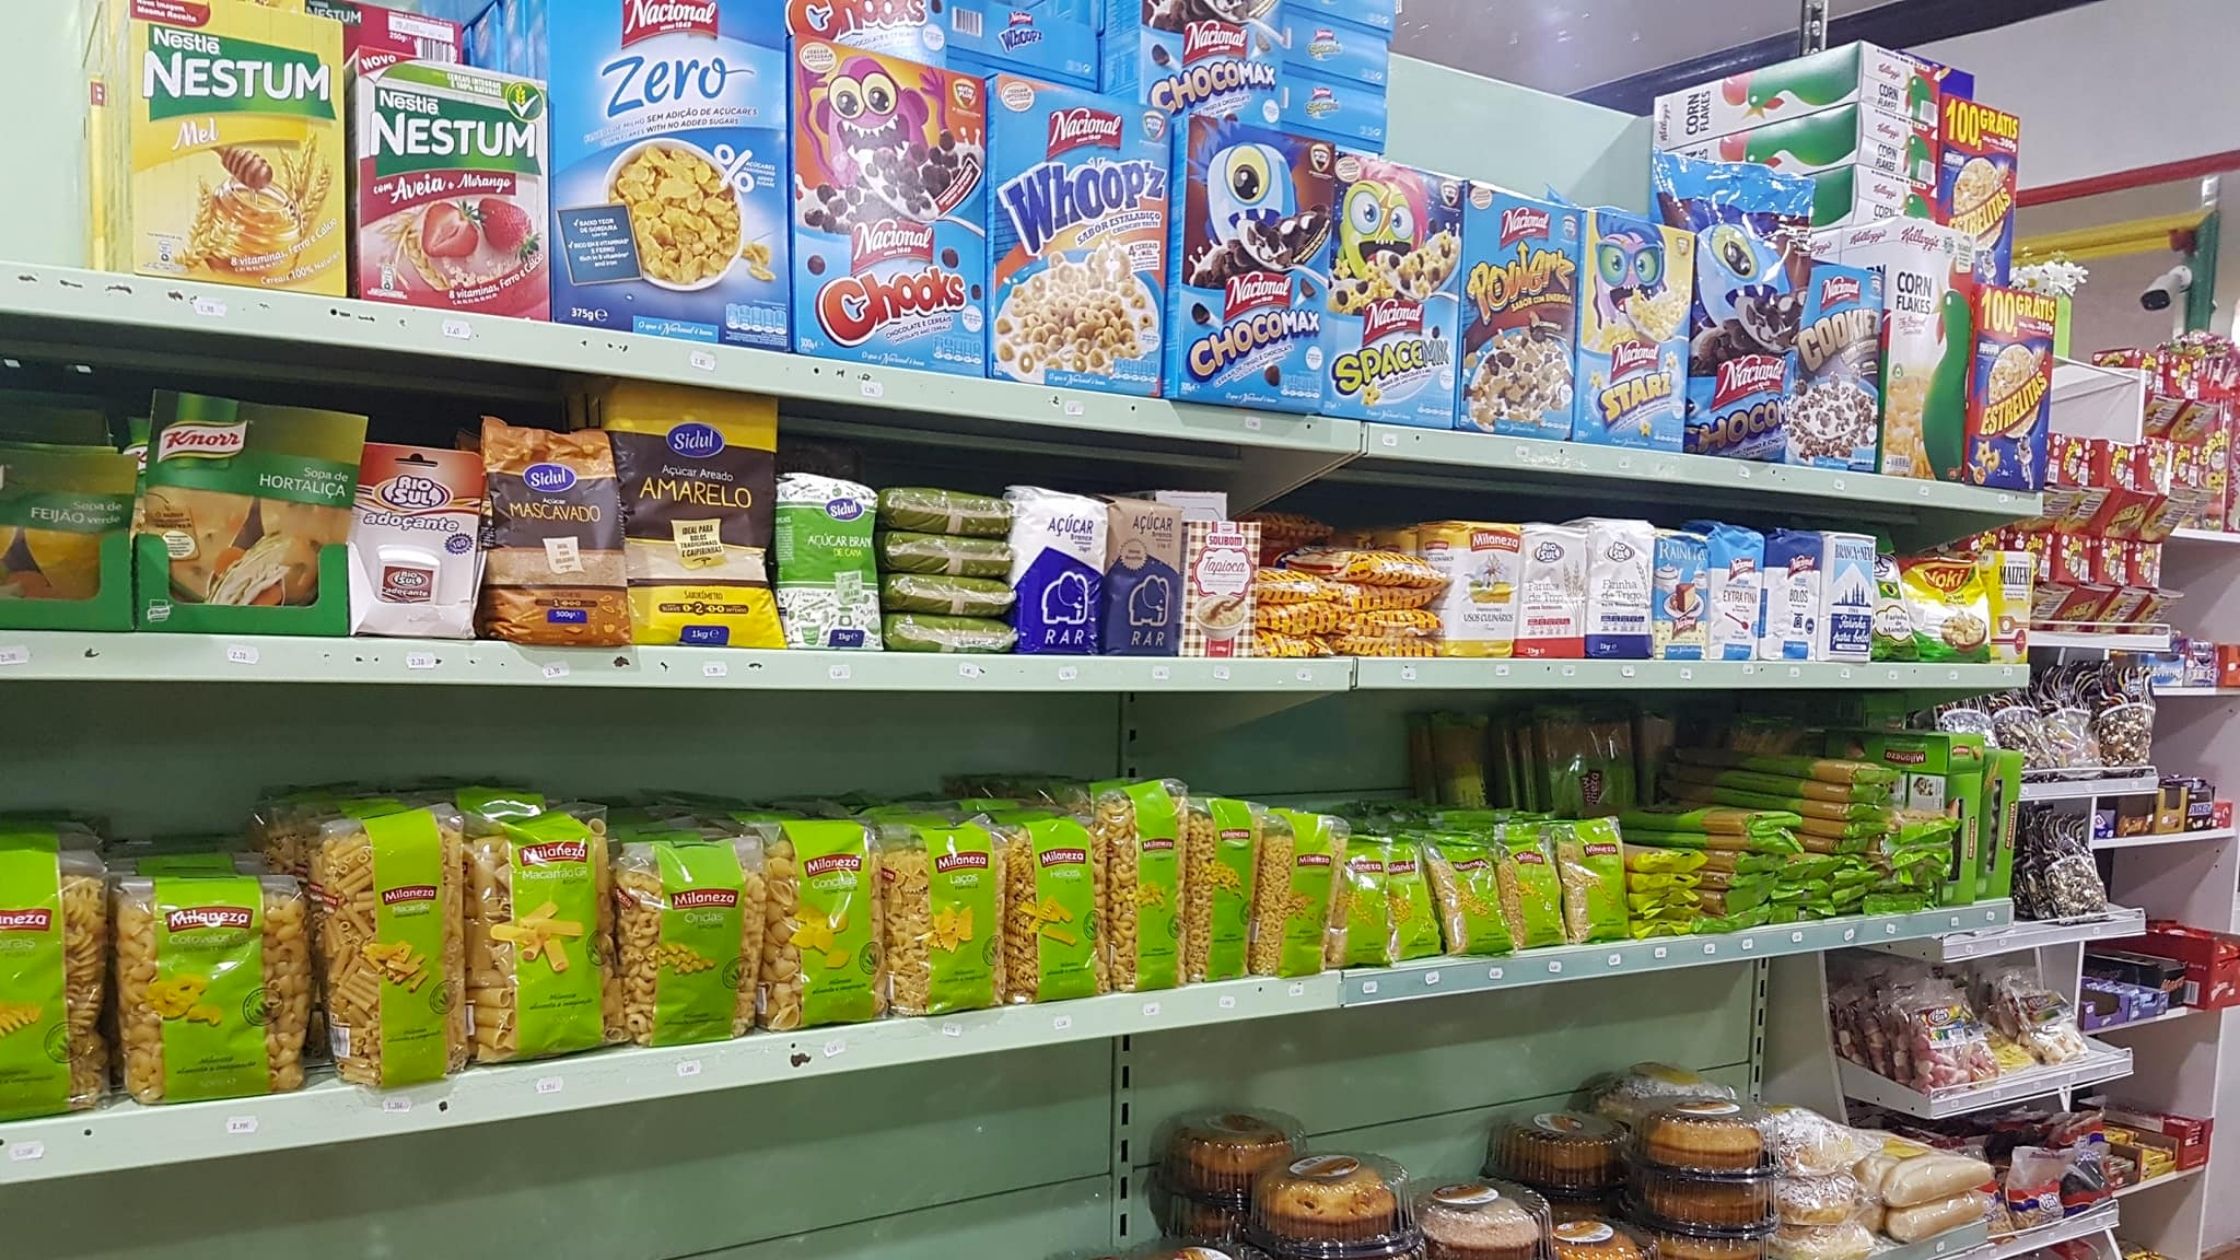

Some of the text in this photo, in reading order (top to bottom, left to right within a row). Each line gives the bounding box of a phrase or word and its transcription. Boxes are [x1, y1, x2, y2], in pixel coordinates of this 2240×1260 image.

[625, 0, 715, 34] Nacional
[1185, 20, 1247, 54] Nacional
[361, 53, 396, 71] NOVO
[143, 50, 329, 101] NESTUM
[602, 56, 755, 118] Zero
[1151, 61, 1276, 113] CHOCOMAX
[1878, 83, 1899, 101] CORN
[646, 113, 664, 123] SEM
[666, 107, 698, 121] ADIÇÃO
[700, 108, 711, 116] DE
[1686, 93, 1701, 136] CORN
[1700, 90, 1711, 132] FLAKES
[172, 117, 219, 150] Mel
[370, 112, 538, 158] NESTUM
[646, 124, 666, 134] WITH
[667, 121, 680, 131] NO
[681, 118, 707, 128] ADDED
[1050, 107, 1122, 147] Nacional
[1877, 143, 1897, 161] CORN
[373, 182, 394, 195] com
[390, 173, 446, 204] Aveia
[457, 173, 512, 193] Morango
[1077, 212, 1161, 246] SABOR ESTALADIÇO
[1500, 207, 1549, 239] Nacional
[854, 219, 932, 260] Nacional
[1901, 225, 1940, 251] Kellogg's
[1128, 244, 1136, 257] 4
[230, 257, 237, 267] 8
[456, 285, 500, 299] vitaminas,
[500, 273, 520, 289] Ferro
[1226, 271, 1293, 311] Nacional
[1822, 275, 1861, 305] Nacional
[1897, 271, 1933, 298] CORN
[571, 306, 594, 321] 375g
[820, 267, 966, 345] Chooks
[1511, 299, 1532, 311] SABOR
[1896, 295, 1931, 315] FLAKES
[1364, 298, 1424, 335] Nacional
[1190, 311, 1320, 376] CHOCOMAX
[1613, 340, 1660, 370] Nacional
[1716, 354, 1785, 400] Nacional
[1600, 372, 1672, 424] STARZ
[1980, 371, 2049, 436] ESTRELITAS
[165, 430, 241, 449] Knorr
[674, 431, 714, 451] Sidul
[303, 467, 348, 482] Sopa de
[531, 467, 567, 487] Sidul
[661, 465, 734, 482] Açúcar Areado
[258, 472, 346, 498] HORTALIÇA
[397, 476, 433, 491] RIO
[392, 488, 432, 506] SUL
[639, 477, 752, 509] AMARELO
[31, 506, 85, 524] FEIJÃO
[72, 501, 122, 514] Sopa de
[509, 502, 601, 522] MASCAVADO
[830, 501, 857, 518] Sidul
[363, 511, 460, 533] adoçante
[682, 525, 714, 536] IDEAL PARA
[1047, 514, 1094, 537] AÇÚCAR
[1132, 512, 1173, 535] AÇÚCAR
[681, 541, 719, 549] TRADICIONAIS
[808, 533, 847, 548] AÇÚCAR
[1208, 535, 1242, 546] SOLIBOM
[1472, 532, 1519, 549] Milaneza
[686, 546, 723, 557] CAIPIRINHAS
[833, 548, 842, 557] DE
[1203, 556, 1246, 576] Tapioca
[1925, 569, 1966, 588] Yoki
[385, 587, 430, 598] adoçante
[1723, 589, 1744, 602] EXTRA
[1789, 589, 1809, 603] BOLOS
[1463, 613, 1483, 623] USOS
[691, 629, 709, 640] 1kg
[1045, 629, 1085, 645] RAR
[1131, 630, 1164, 646] RAR
[1833, 630, 1852, 644] para
[1886, 751, 1925, 764] Milaneza
[523, 844, 586, 861] Milaneza
[1143, 840, 1174, 851] Milaneza
[807, 856, 861, 874] Milaneza
[938, 855, 988, 871] Milaneza
[1041, 850, 1086, 865] Milaneza
[521, 868, 573, 881] Macarrão
[949, 873, 979, 888] Laços
[385, 888, 436, 904] Milaneza
[674, 891, 736, 908] Milaneza
[170, 912, 249, 928] Milaneza
[684, 911, 724, 924] Ondas
